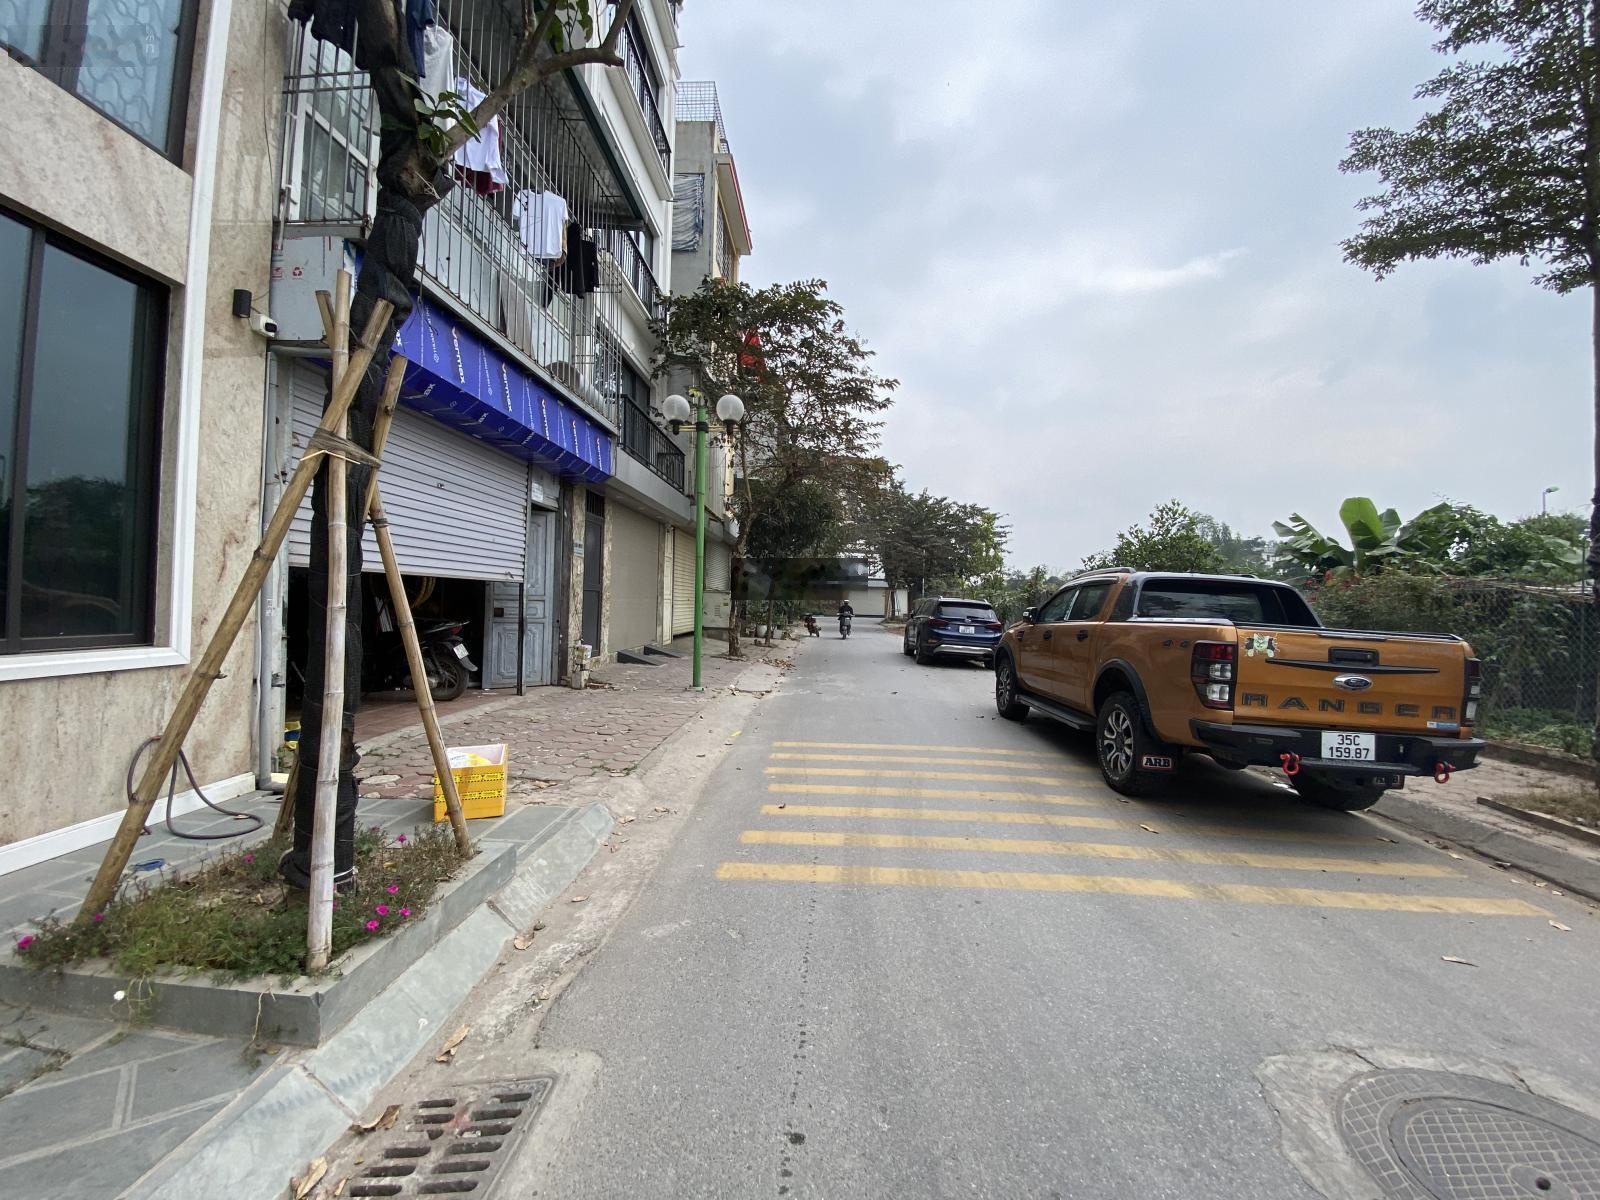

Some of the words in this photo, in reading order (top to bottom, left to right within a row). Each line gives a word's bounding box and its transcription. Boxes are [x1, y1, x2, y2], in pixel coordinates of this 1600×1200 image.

[1242, 692, 1456, 720] RANGER
[1337, 734, 1360, 746] 35C
[1329, 746, 1370, 759] 159.87
[1143, 757, 1171, 768] ARB
